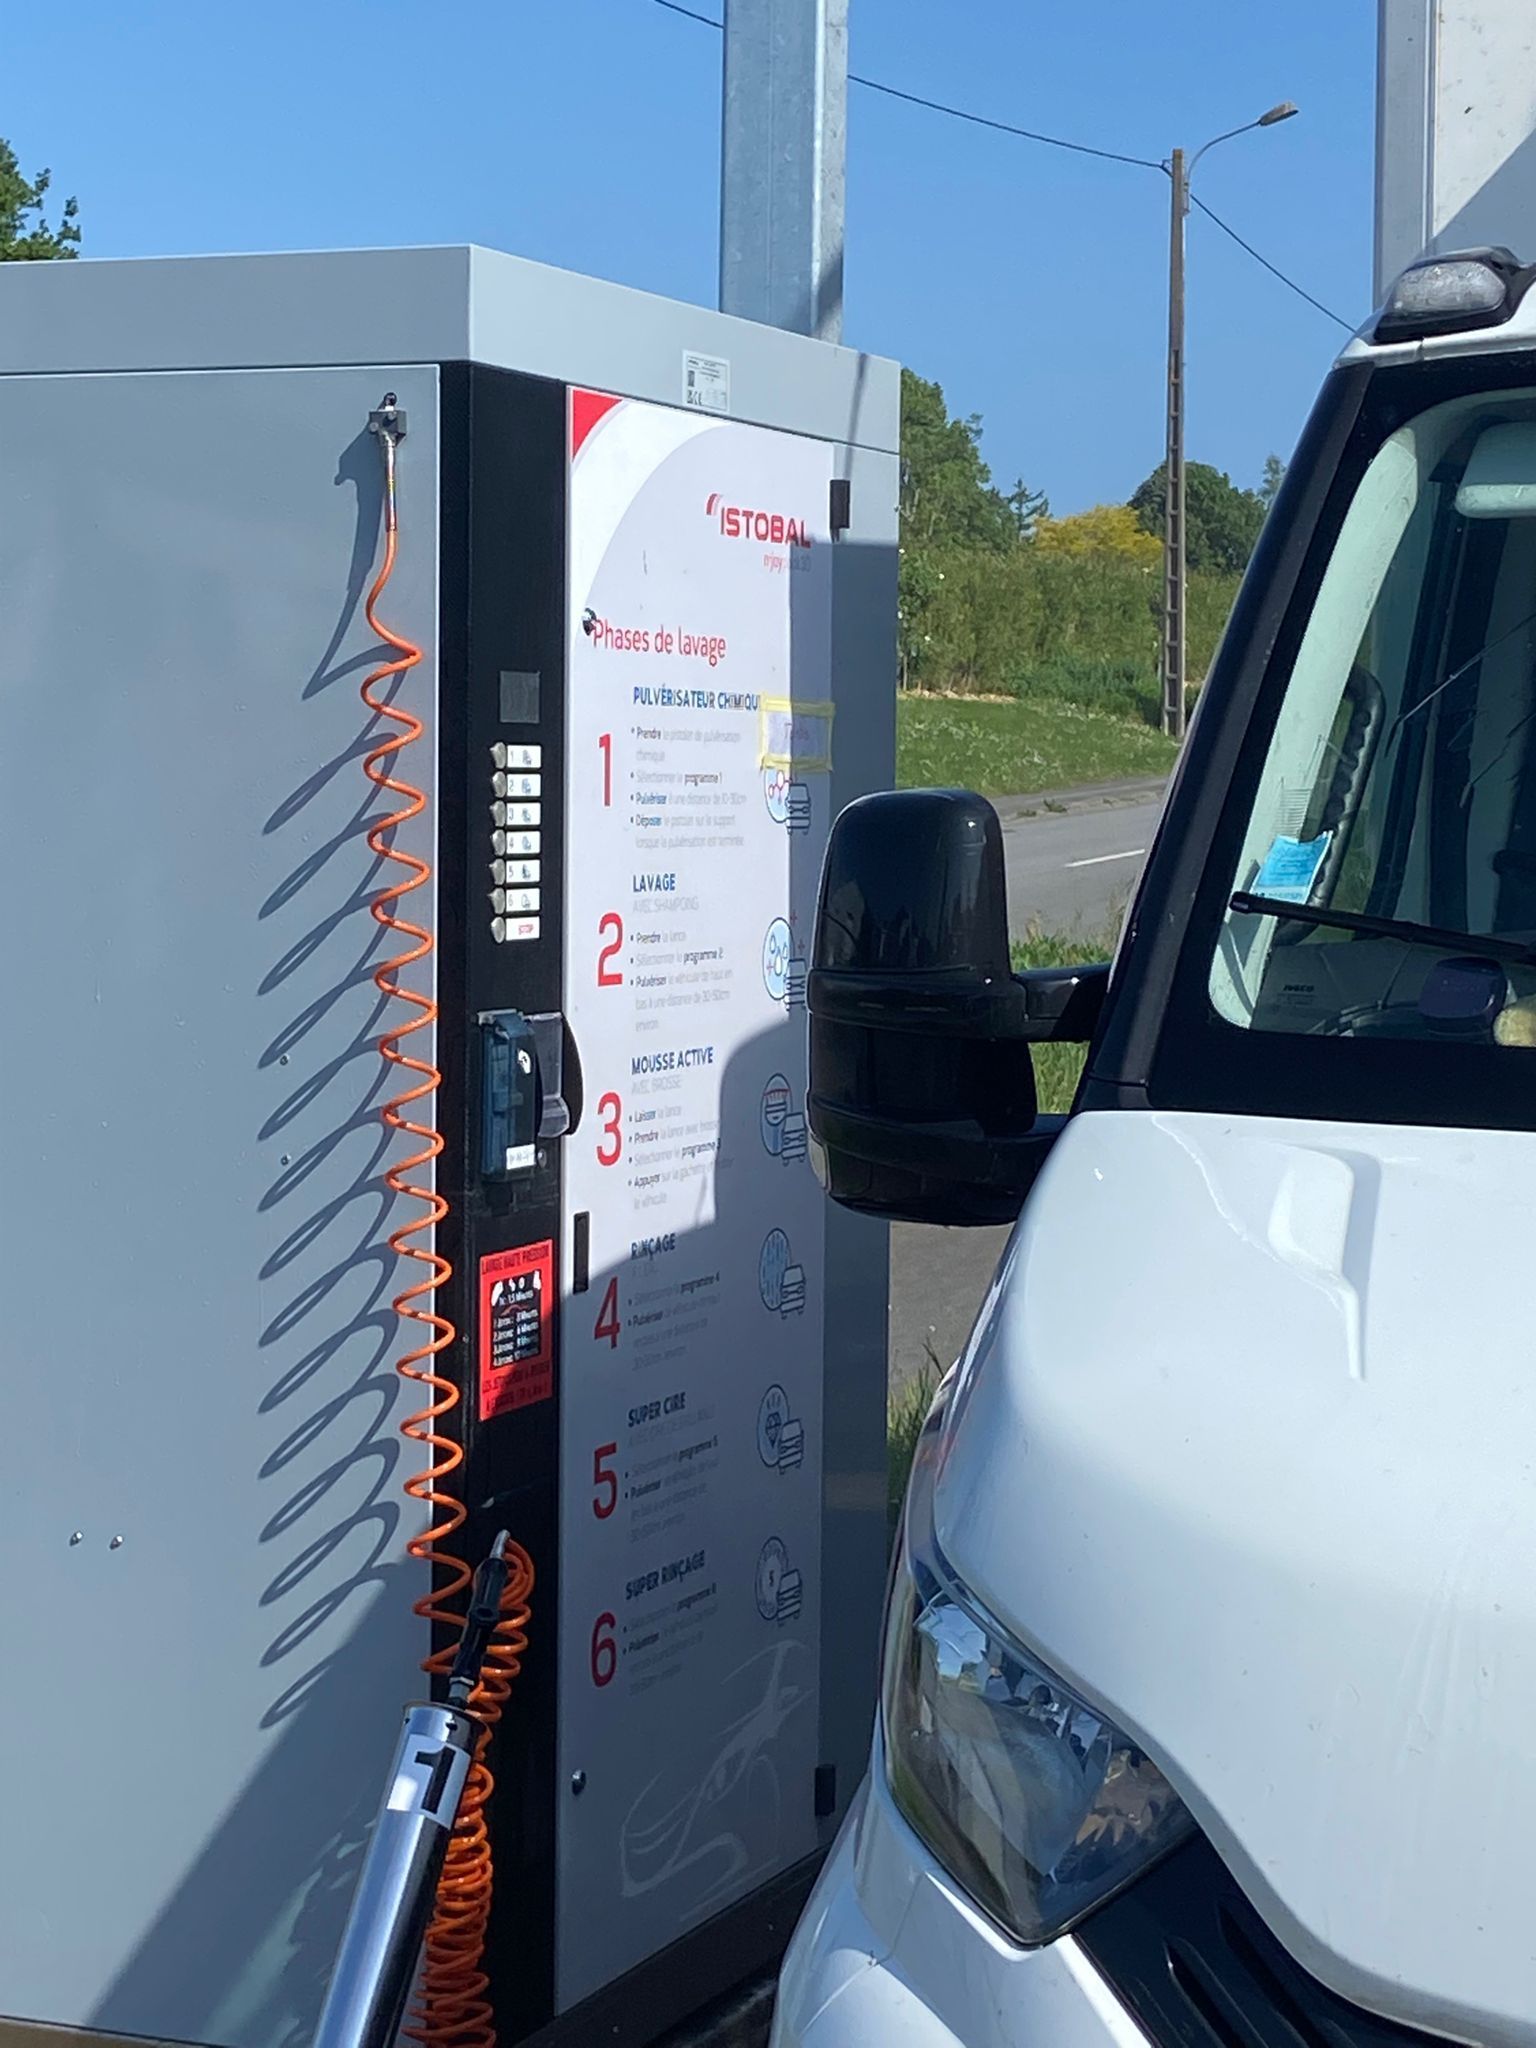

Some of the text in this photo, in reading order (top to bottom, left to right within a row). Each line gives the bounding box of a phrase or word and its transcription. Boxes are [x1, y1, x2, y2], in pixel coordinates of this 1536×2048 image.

[721, 507, 811, 549] ISTOBAL
[593, 619, 726, 667] Phases de lavage
[633, 684, 760, 711] PULVÉRISATEUR CHIMIQU
[637, 726, 661, 740] Prendre
[599, 733, 611, 806] 1
[684, 773, 718, 787] programme
[636, 813, 662, 829] Déposer
[633, 874, 676, 892] LAVAGE
[598, 913, 623, 987] 2
[636, 932, 661, 944] Prendre
[683, 950, 717, 965] programme
[631, 1046, 713, 1075] MOUSSE ACTIVE
[596, 1092, 622, 1166] 3
[634, 1130, 659, 1144] Prendre
[681, 1141, 716, 1160] programme
[631, 1233, 676, 1260] RINÇAGE
[594, 1277, 620, 1349] 4
[628, 1400, 661, 1428] SUPER
[664, 1391, 686, 1415] CIRE
[593, 1442, 618, 1519] 5
[626, 1549, 705, 1600] SUPER RINÇAGE
[591, 1612, 616, 1687] 6
[414, 1746, 456, 1814] 1
